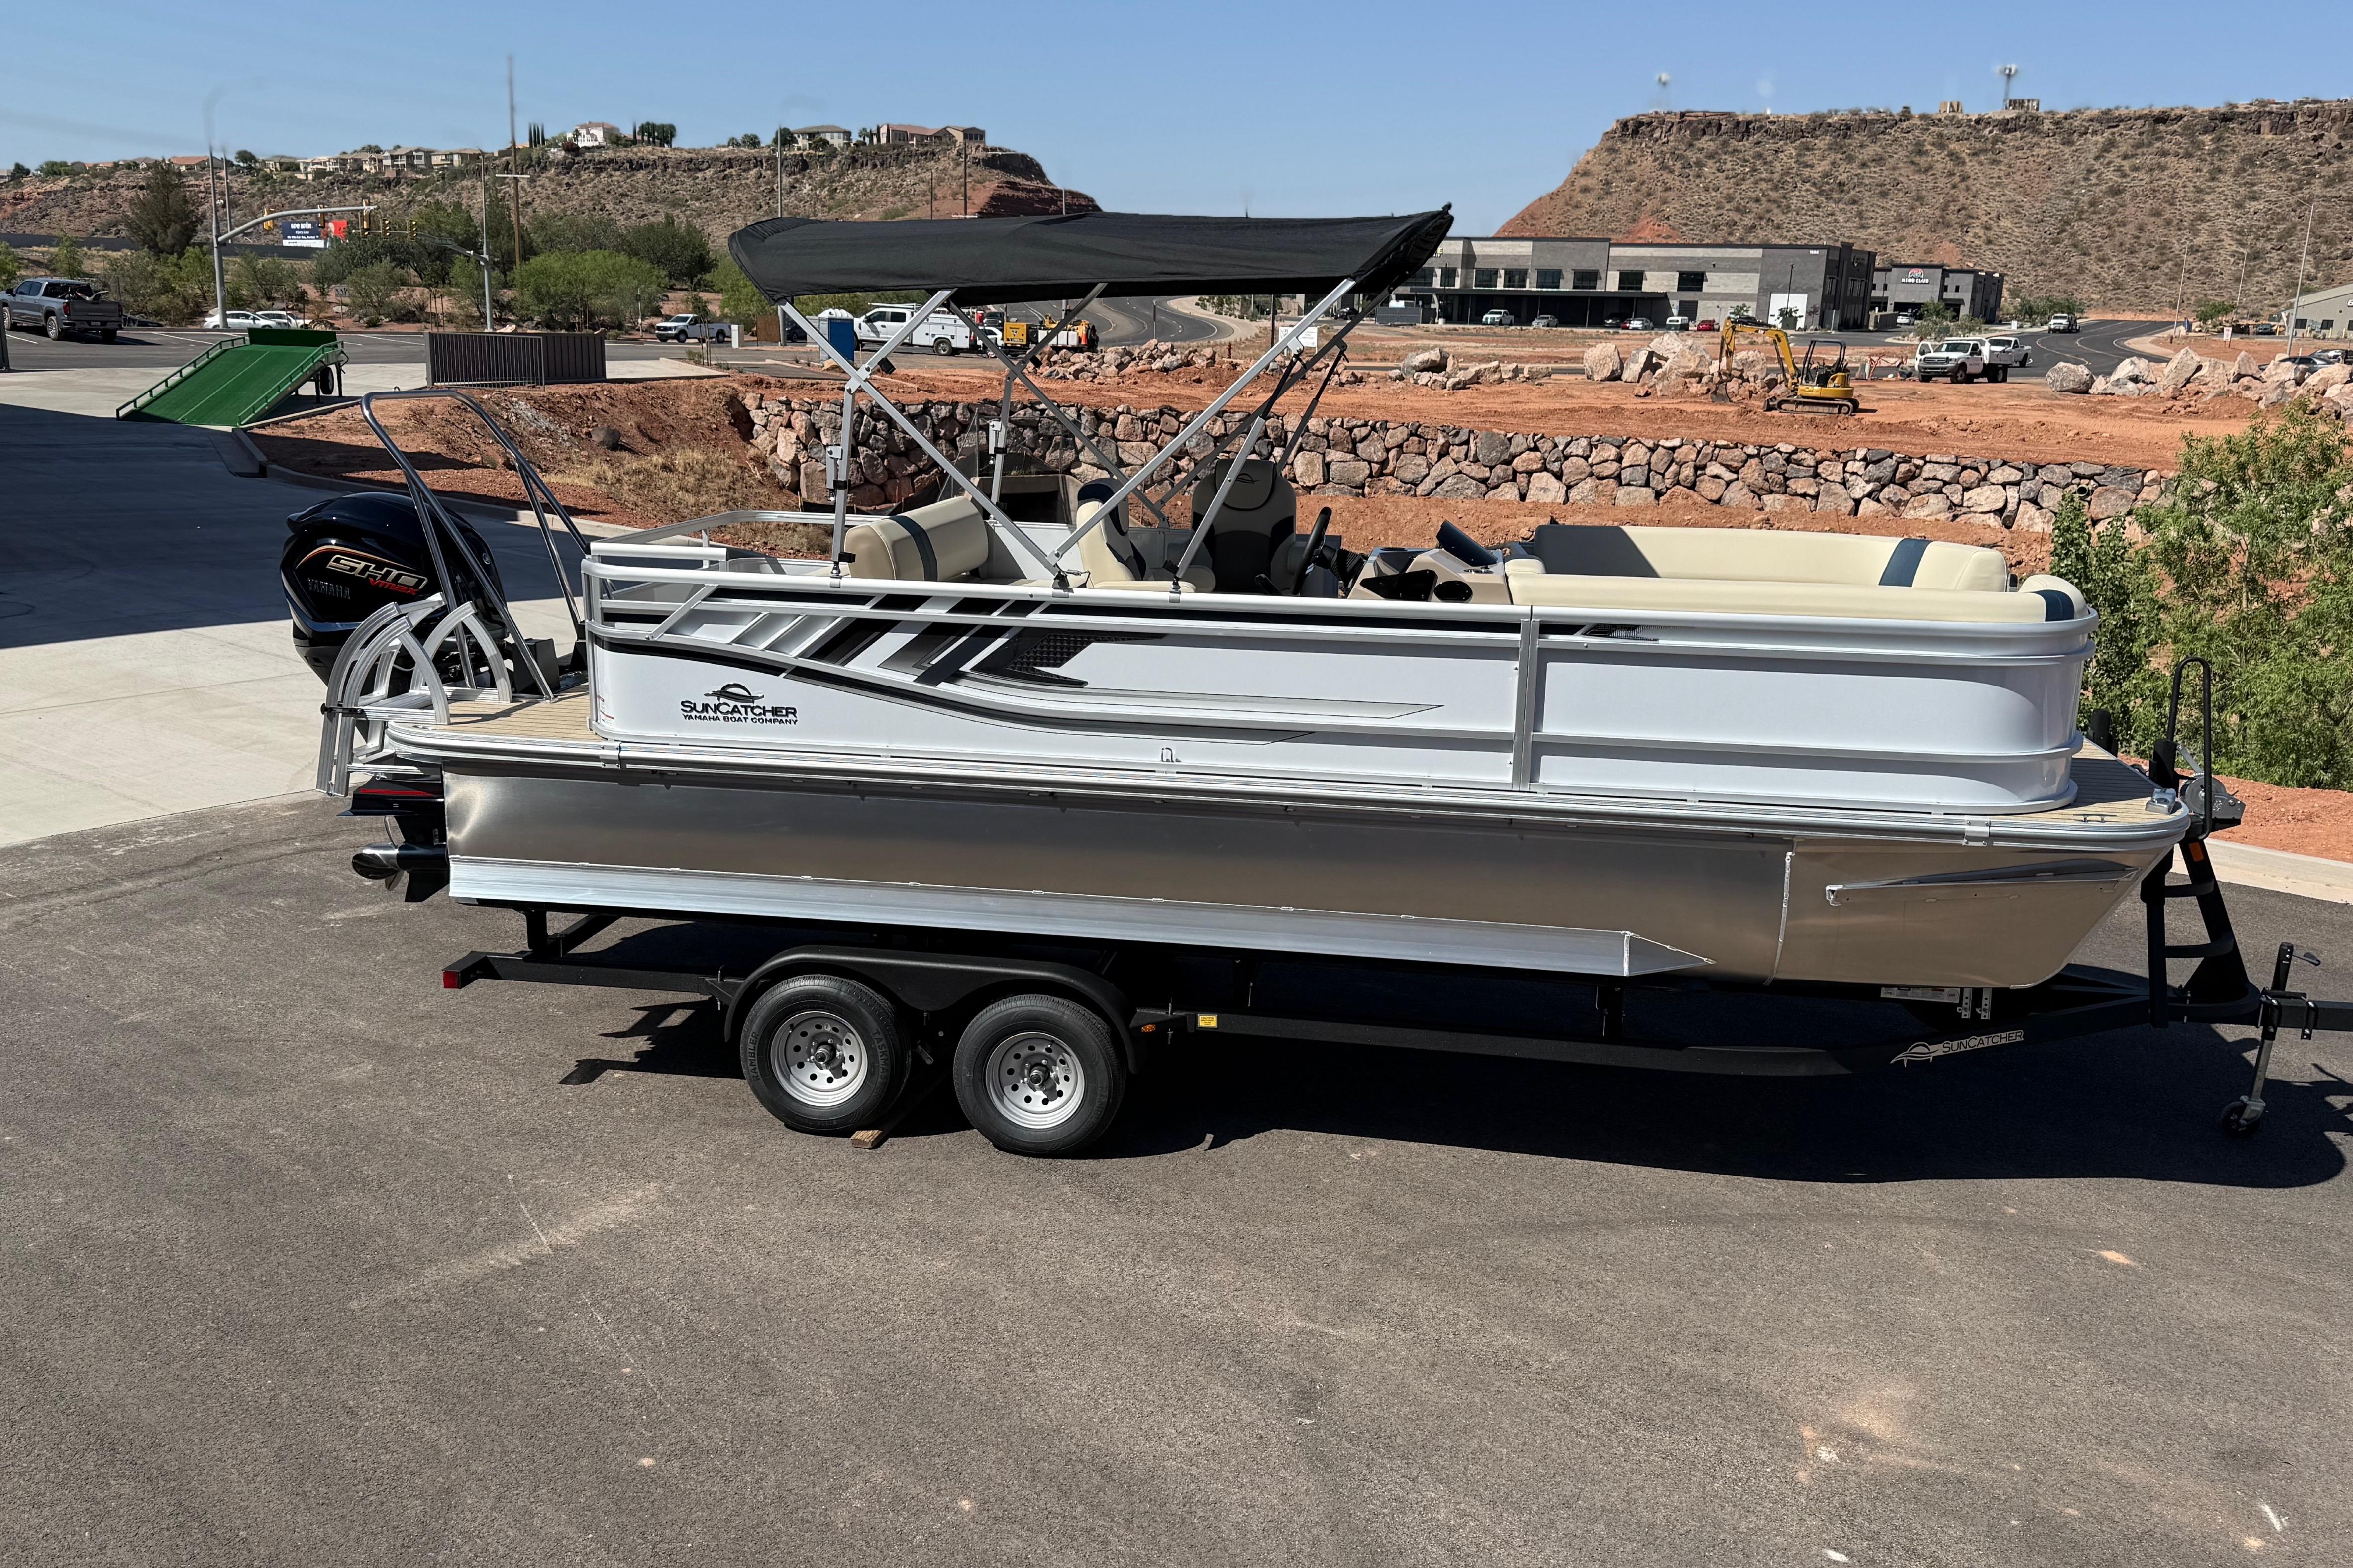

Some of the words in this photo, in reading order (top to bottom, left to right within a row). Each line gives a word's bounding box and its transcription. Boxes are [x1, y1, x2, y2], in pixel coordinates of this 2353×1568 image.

[307, 578, 350, 600] YAMAHA
[326, 555, 428, 589] SHO
[682, 713, 721, 722] YAMAHA
[748, 1031, 760, 1082] RAMBLER
[872, 1029, 890, 1098] TASKMASTER
